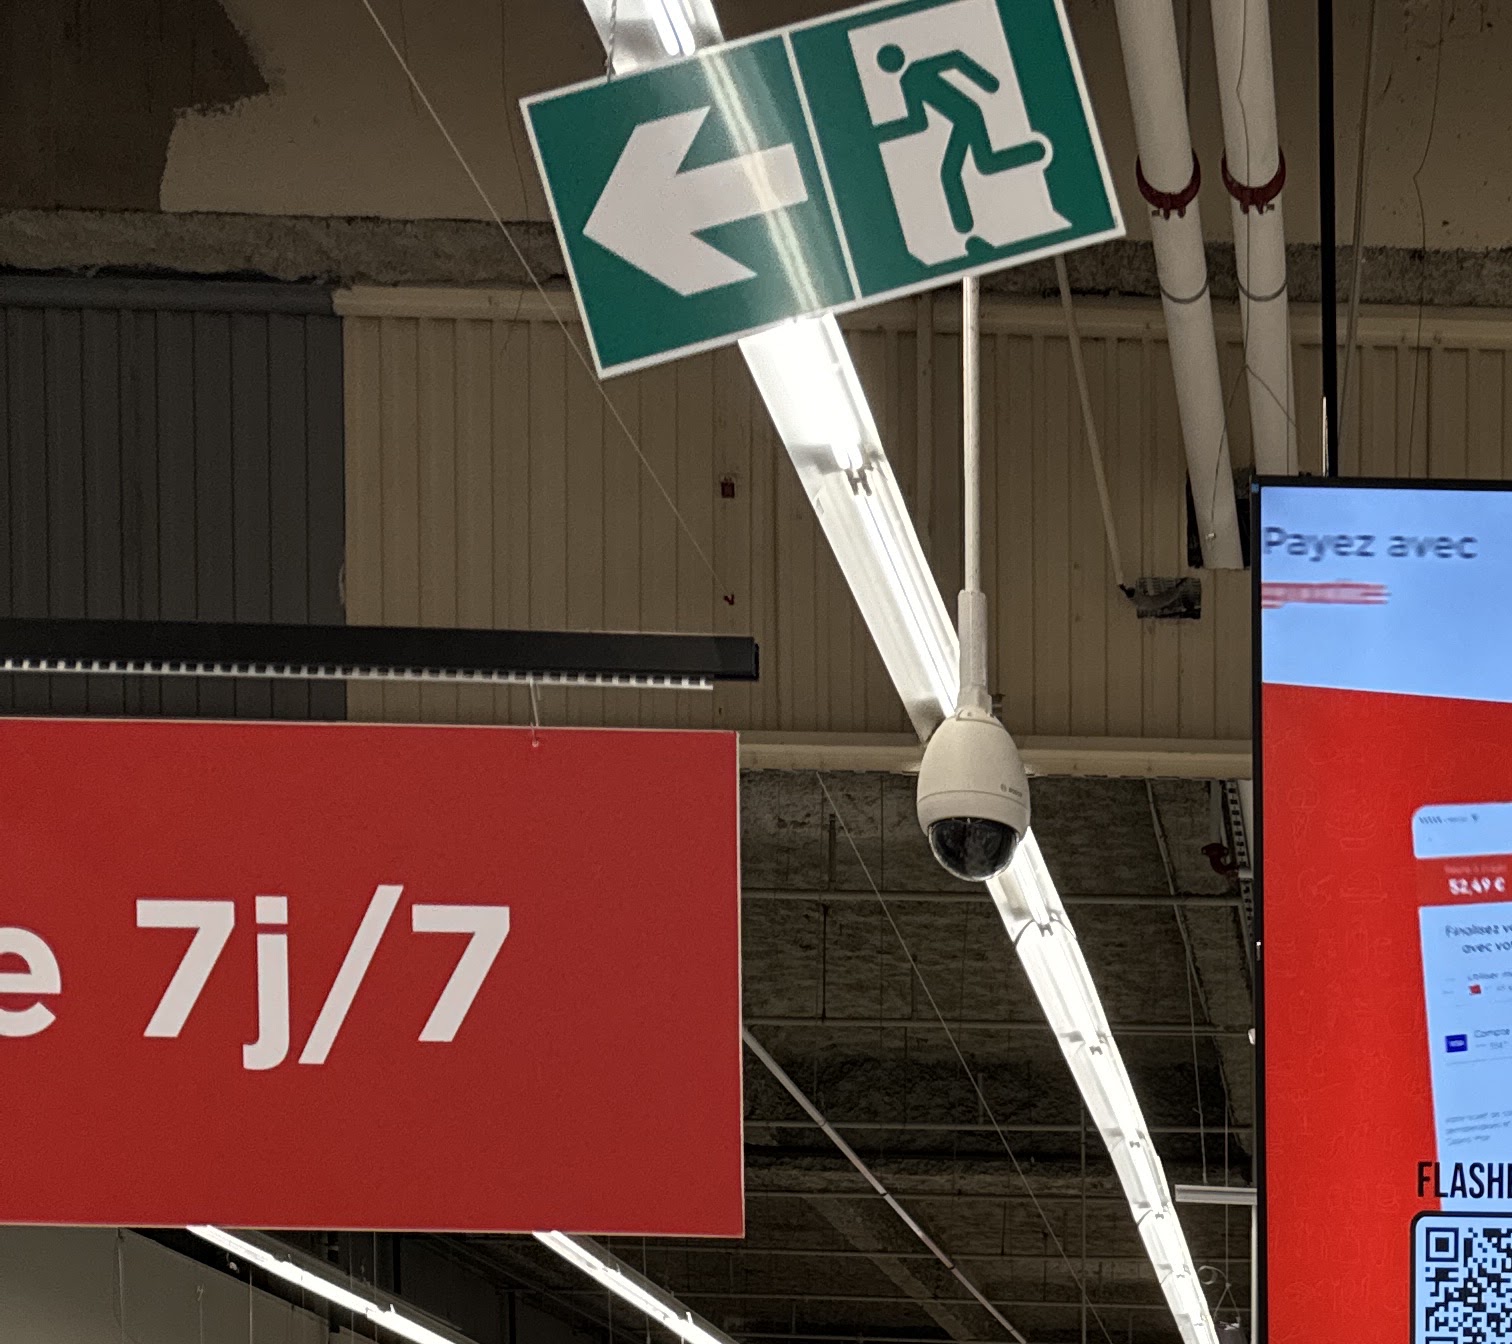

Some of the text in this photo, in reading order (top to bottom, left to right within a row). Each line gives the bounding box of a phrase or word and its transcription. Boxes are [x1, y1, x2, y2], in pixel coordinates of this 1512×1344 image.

[1263, 526, 1479, 562] Payez avec
[1462, 943, 1493, 955] avec
[136, 885, 510, 1070] 7j/7
